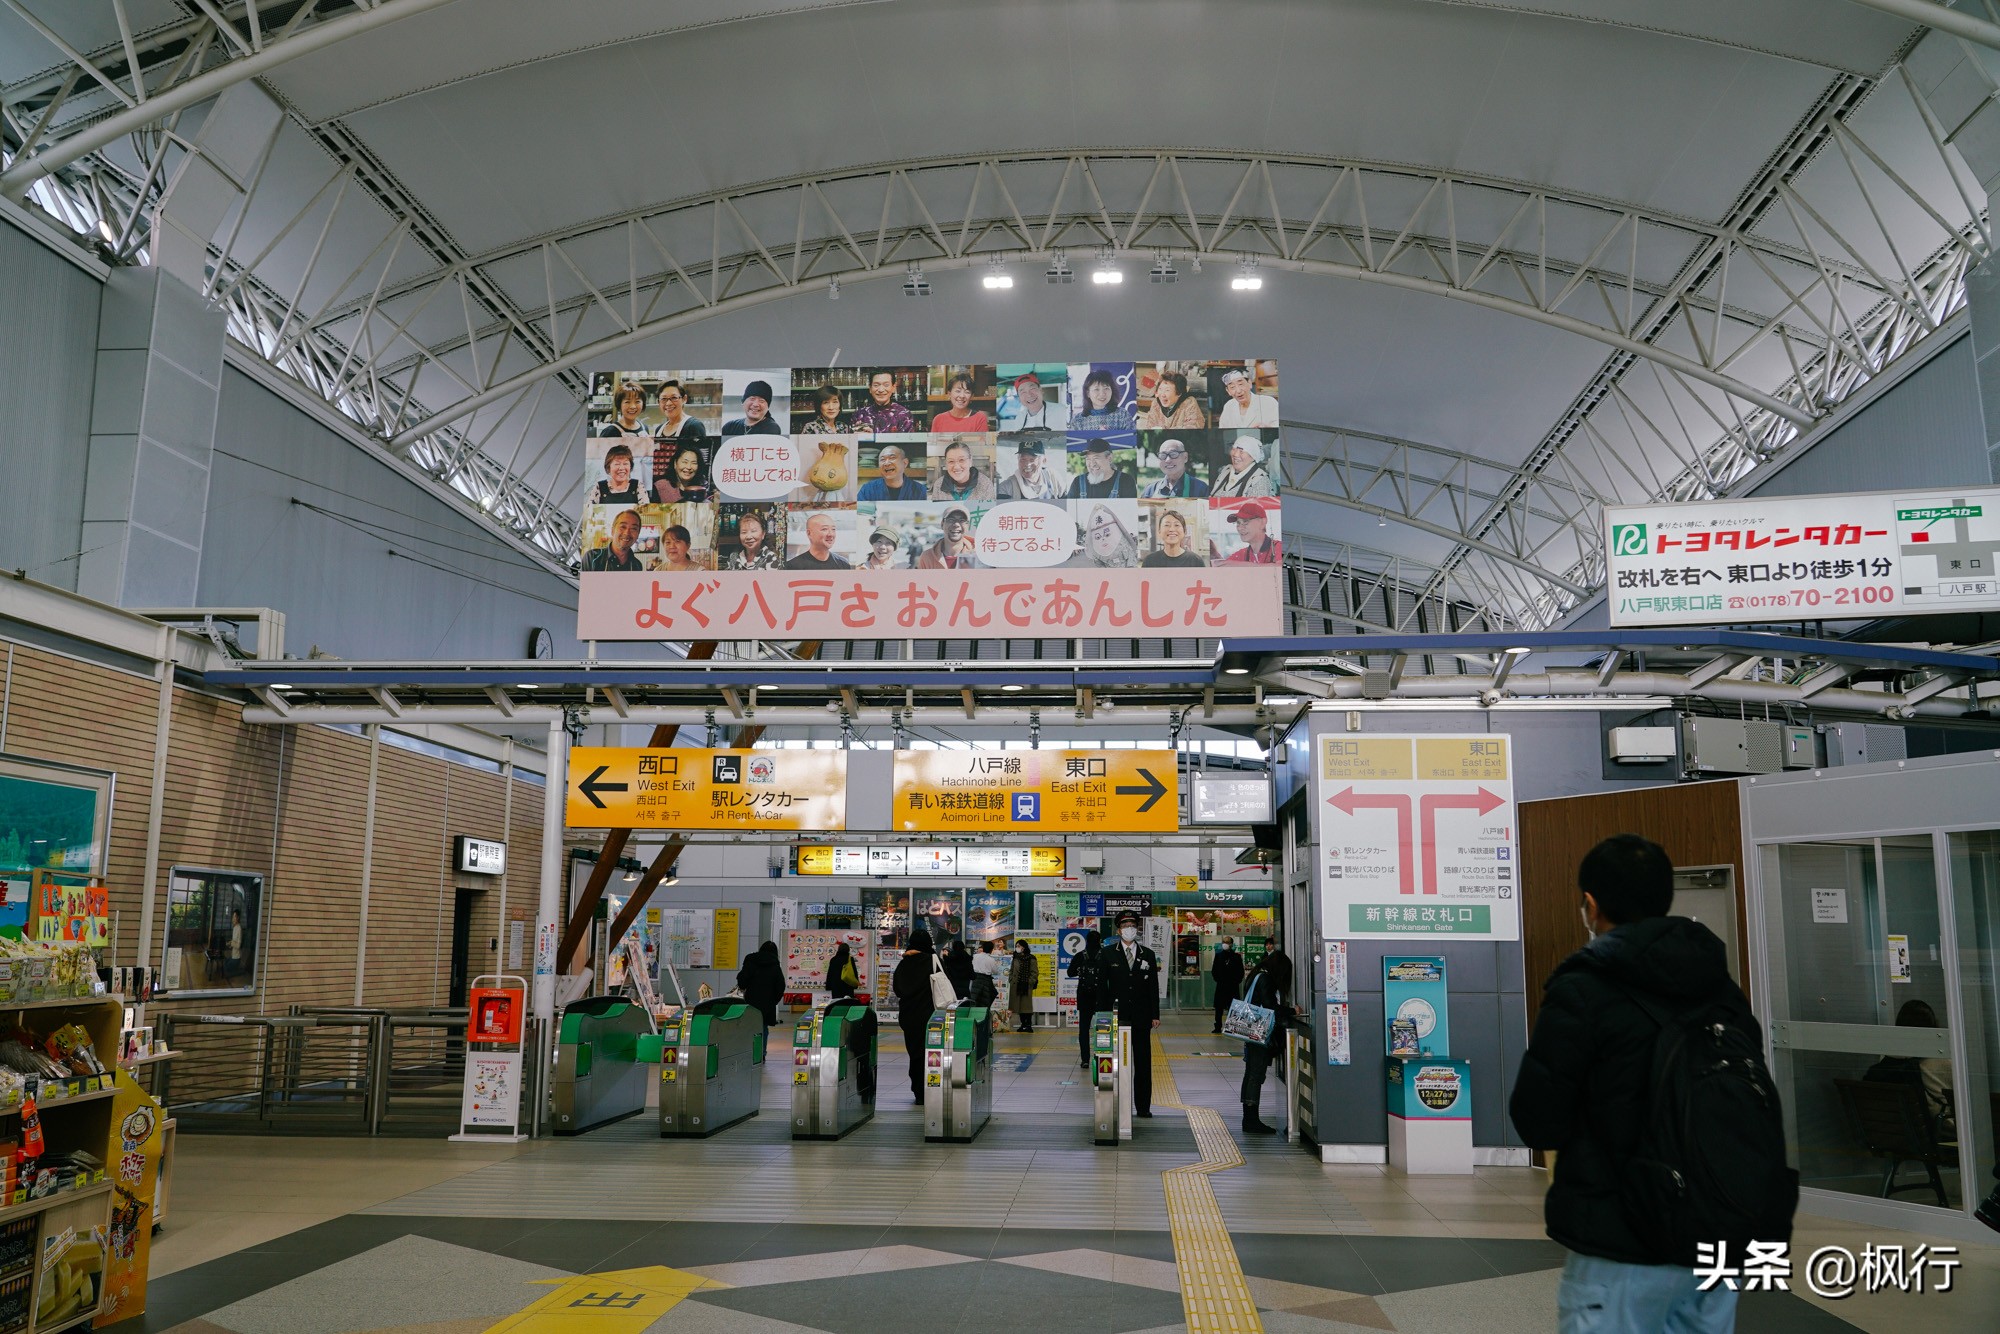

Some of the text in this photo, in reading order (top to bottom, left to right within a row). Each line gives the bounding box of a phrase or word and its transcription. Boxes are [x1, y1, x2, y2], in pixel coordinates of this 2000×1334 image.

[730, 445, 790, 462] 横丁にも
[721, 464, 798, 485] 顔出してね!
[1901, 508, 1980, 520] トヨタレンタカー
[998, 516, 1044, 530] 朝市で
[1655, 517, 1765, 530] 乗りたい時に、乗りたいクルマ
[982, 538, 1061, 552] 待ってるよ!
[1656, 524, 1888, 554] トヨタレンタカー
[1950, 558, 1982, 570] 東口
[1618, 557, 1893, 588] 改札を右へ 東口より徒歩1分
[1949, 583, 1988, 595] 八戸駅
[635, 577, 1228, 629] よぐ八戸さおんであんした
[1619, 594, 1723, 614] 八戸駅東口店
[1328, 742, 1358, 756] 西口
[1469, 742, 1500, 756] 東口
[638, 756, 678, 776] 西口
[969, 756, 1022, 775] 八戸線
[1066, 757, 1107, 778] 東口
[1328, 758, 1370, 766] West Exit
[1462, 758, 1502, 767] East Exit
[638, 780, 696, 791] West Exit
[941, 776, 1022, 787] Hachinohe Line
[1051, 782, 1107, 794] East Exit
[636, 795, 668, 806] 西出口
[711, 790, 810, 808] 駅レンタカー
[908, 792, 1005, 811] 青い森鉄道線
[1075, 796, 1107, 808] 东出口
[636, 810, 656, 821] 서쪽
[710, 810, 783, 820] JR Rent-A-Car
[940, 812, 1005, 823] Aoimori Line
[1060, 812, 1081, 822] 동쪽
[1482, 828, 1504, 836] 八戸線
[1344, 866, 1395, 874] 観光バスのりば
[1444, 866, 1494, 874] 路線バスのりば
[1458, 886, 1496, 894] 観光案内所
[916, 900, 962, 915] はとバス
[1366, 908, 1472, 922] 新幹線改札口
[570, 1292, 646, 1308] 出
